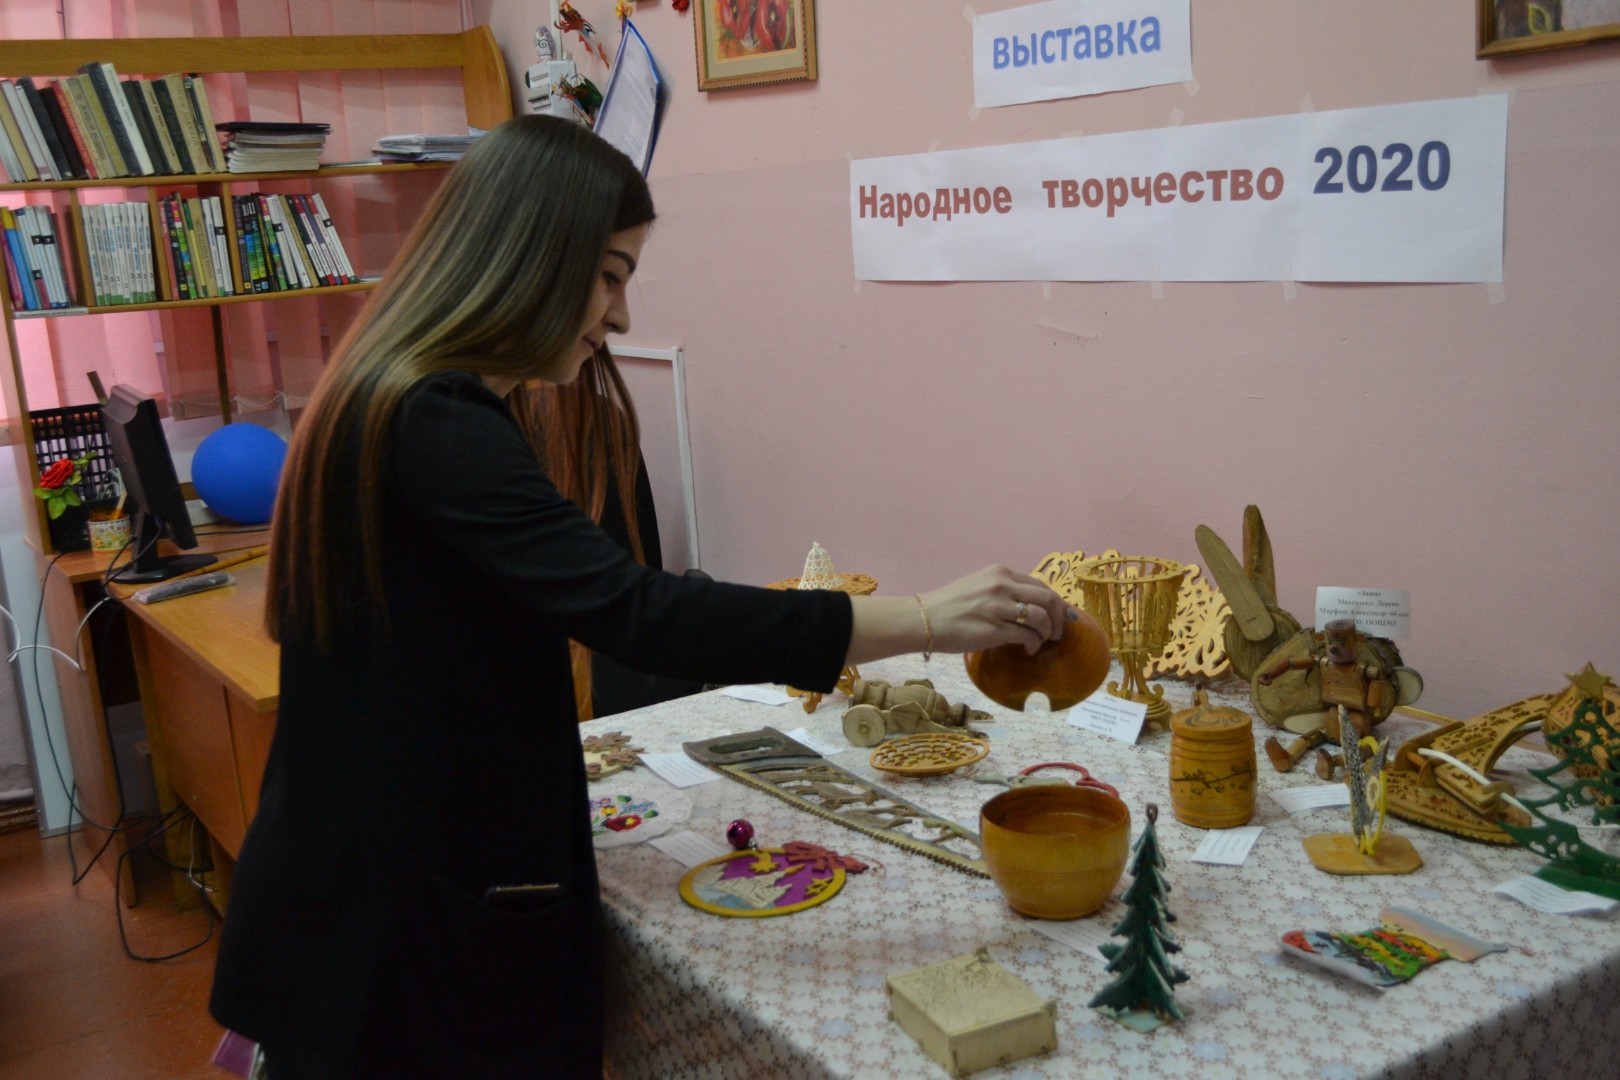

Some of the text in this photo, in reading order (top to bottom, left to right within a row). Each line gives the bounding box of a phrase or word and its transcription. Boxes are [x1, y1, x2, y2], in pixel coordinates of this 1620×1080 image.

[858, 139, 1452, 228] Народное творчество 2020
